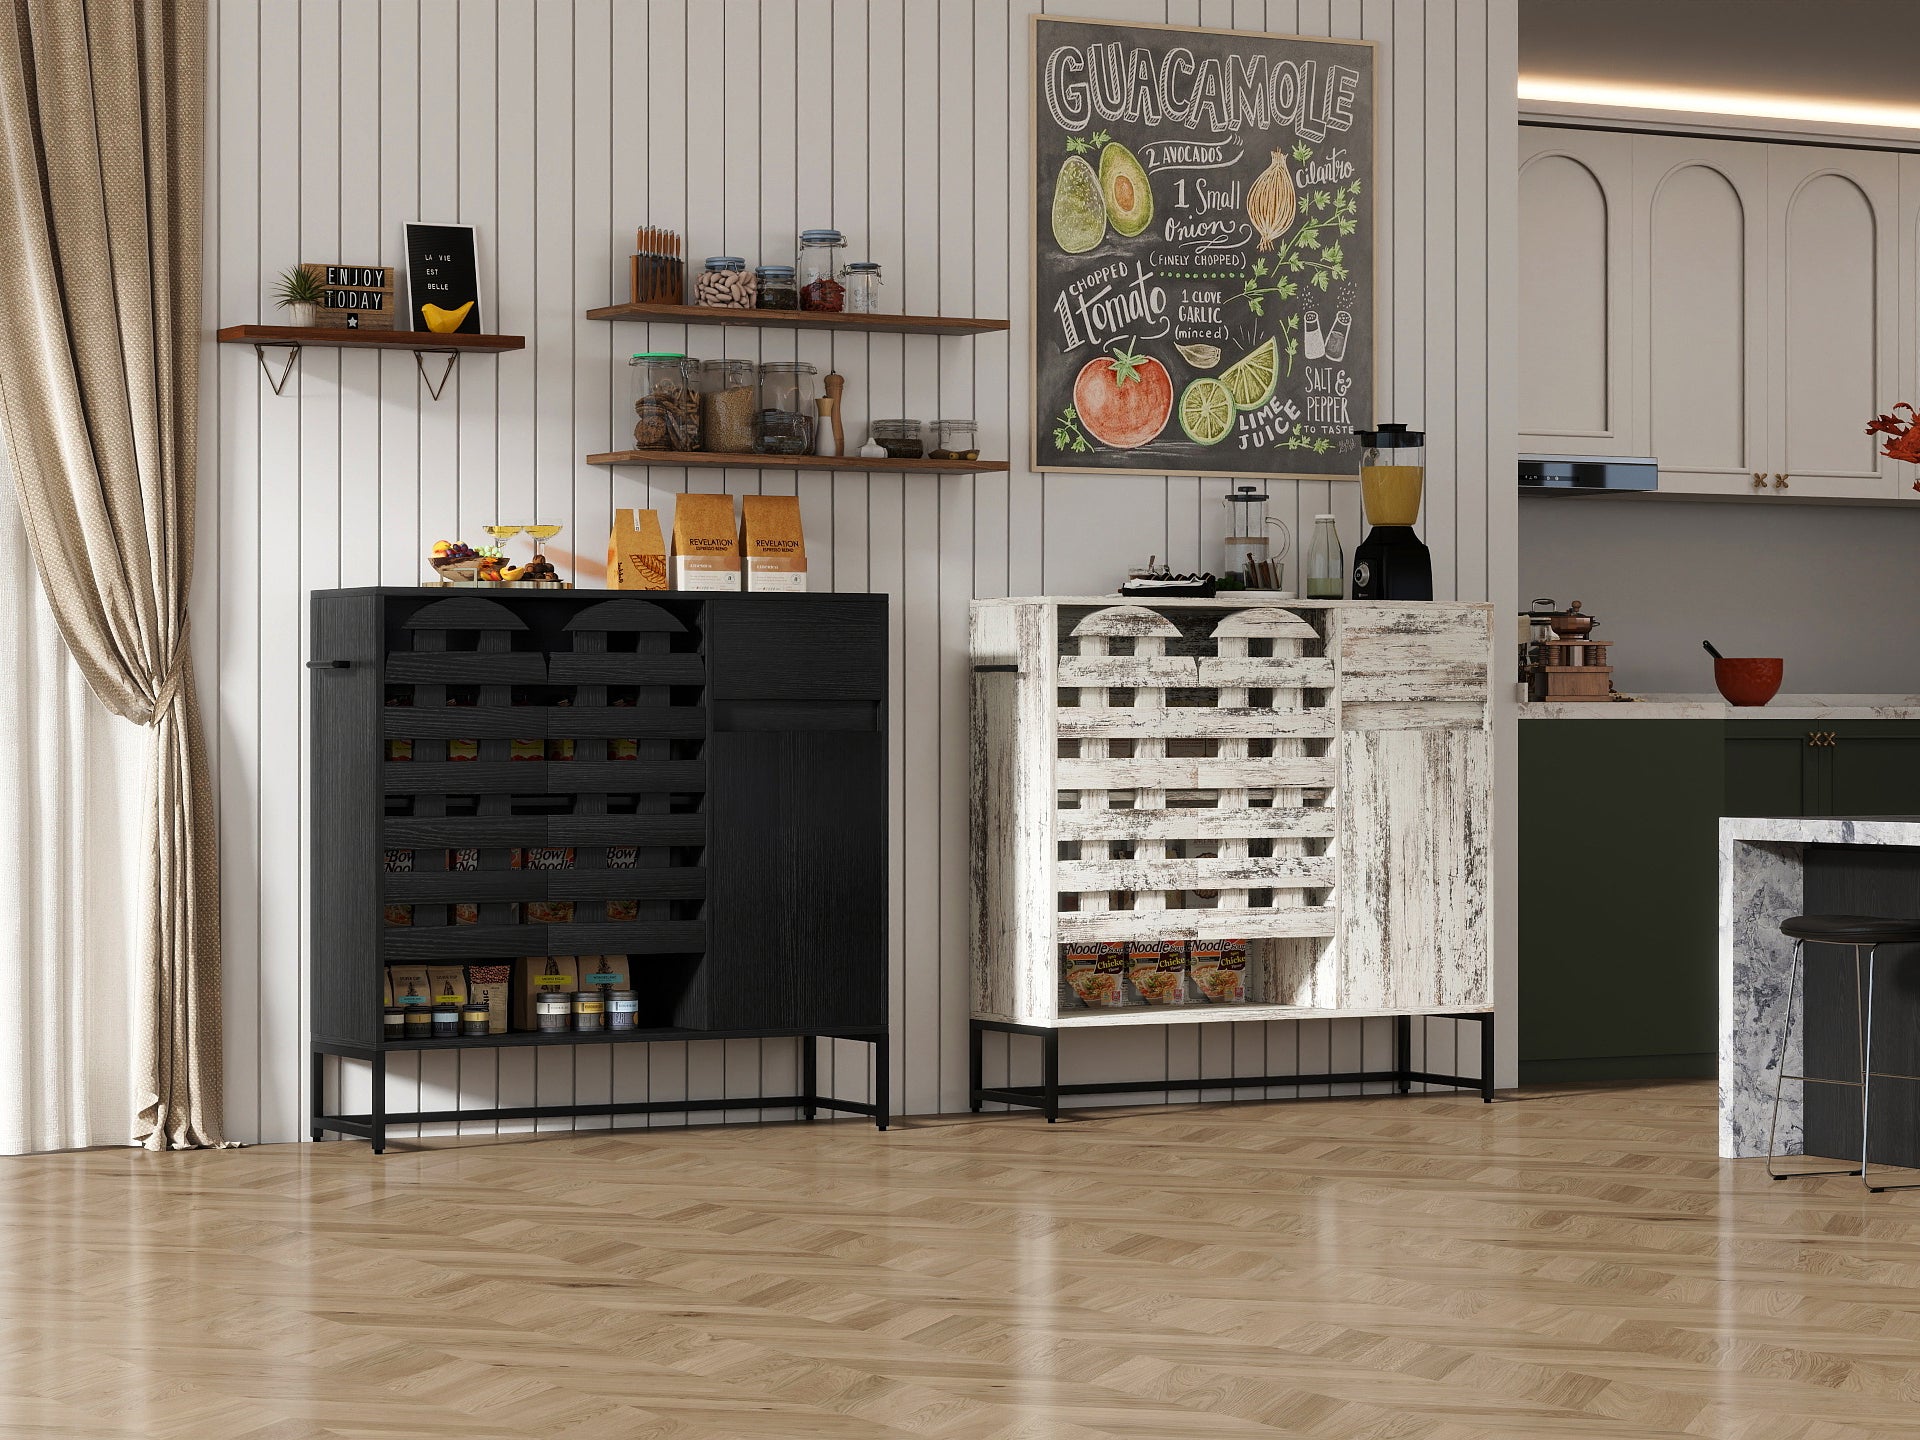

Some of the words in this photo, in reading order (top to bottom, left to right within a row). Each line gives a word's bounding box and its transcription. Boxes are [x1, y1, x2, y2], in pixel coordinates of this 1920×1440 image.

[1045, 41, 1360, 143] GUACAMOLE
[1146, 148, 1160, 168] 2
[1163, 146, 1223, 164] AVOCADOS
[1173, 178, 1190, 209] 1
[1195, 178, 1241, 215] Small
[1194, 252, 1247, 269] CHOPPED)
[328, 267, 384, 287] ENJOY
[426, 268, 439, 276] EST
[1068, 262, 1129, 297] CHOPPED
[427, 283, 449, 291] BELLE
[325, 291, 383, 310] TODAY
[1181, 289, 1189, 304] 1
[1191, 290, 1222, 304] CLOVE
[1053, 290, 1085, 353] 1
[1178, 305, 1223, 324] GARLIC
[1175, 325, 1230, 341] (minced)
[1305, 367, 1333, 394] SALT
[1335, 370, 1352, 397] &
[1239, 395, 1285, 432] LIME
[1307, 397, 1351, 424] PEPPER
[1238, 399, 1301, 451] JUICE
[1304, 425, 1317, 434] TO
[1321, 425, 1354, 435] TASTE
[689, 538, 733, 546] REVELATION
[755, 539, 799, 548] REVELATION
[530, 847, 567, 860] Bowl
[528, 860, 575, 871] Noodle
[1067, 942, 1108, 955] Noodle
[1129, 940, 1170, 953] Noodle
[1191, 939, 1231, 952] Noodle
[1097, 958, 1124, 970] Chicke
[1159, 957, 1185, 968] Chicke
